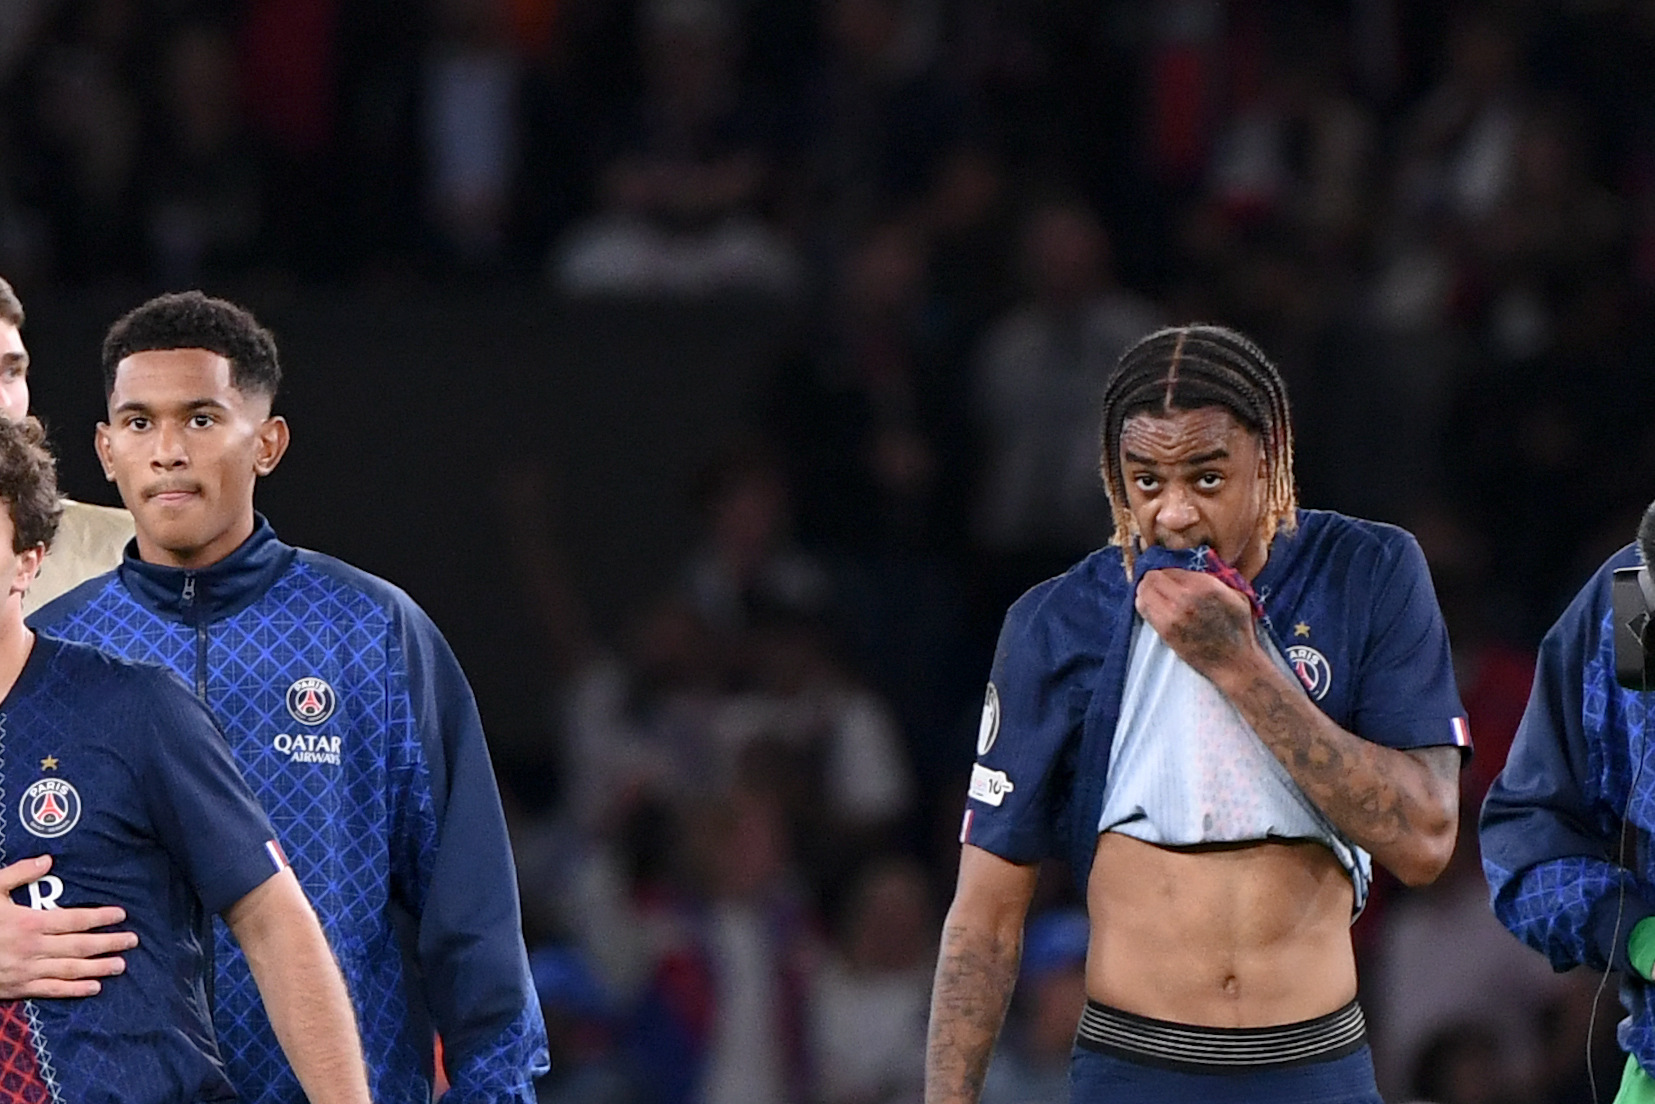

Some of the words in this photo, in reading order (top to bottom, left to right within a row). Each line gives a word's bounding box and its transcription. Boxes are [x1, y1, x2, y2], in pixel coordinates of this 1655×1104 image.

[1289, 650, 1319, 664] ARIS
[273, 734, 341, 755] QATAR
[290, 751, 341, 766] AIRWAYS
[29, 781, 69, 797] PARIS
